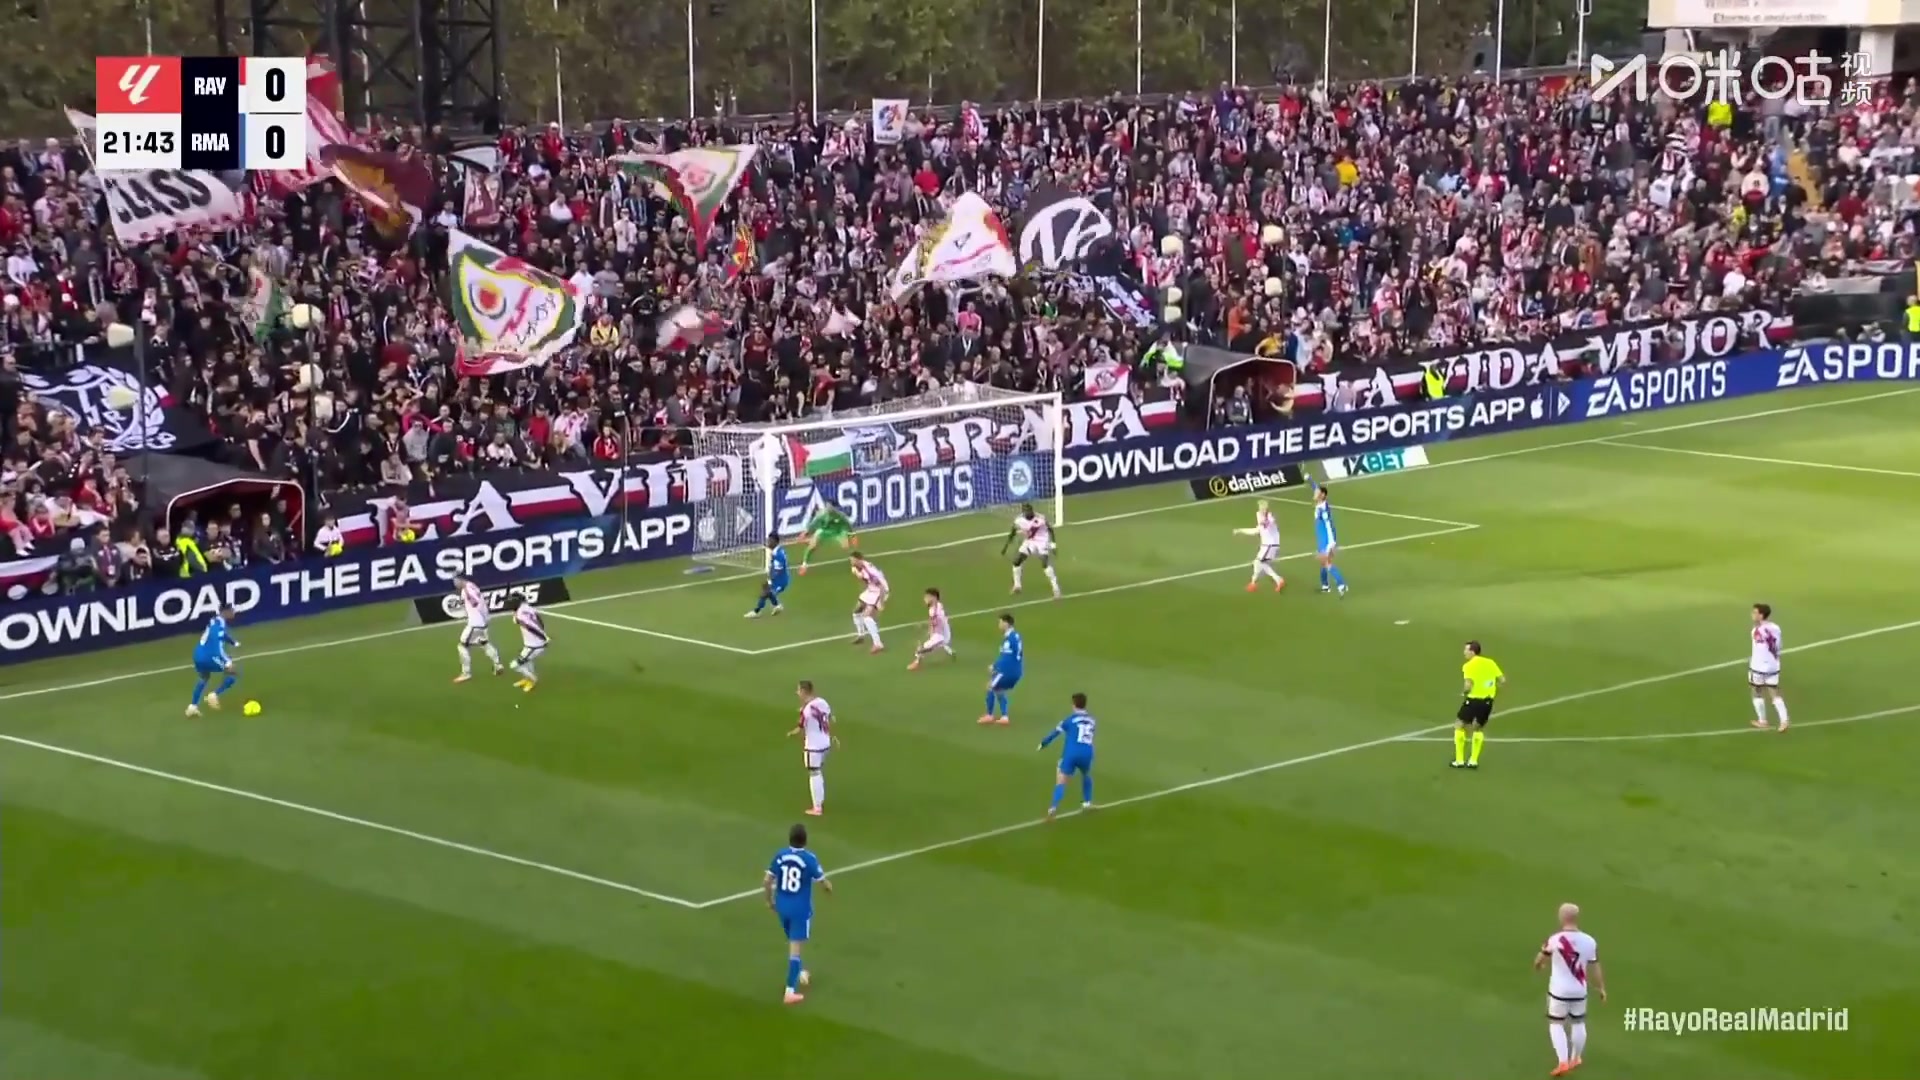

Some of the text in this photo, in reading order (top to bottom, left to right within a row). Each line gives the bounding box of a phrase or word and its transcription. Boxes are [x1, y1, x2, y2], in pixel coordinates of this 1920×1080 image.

[1586, 361, 1727, 417] EA SPORTS
[1777, 345, 1819, 388] EA
[1061, 396, 1525, 486] DOWNLOAD THE EA SPORTS APP
[837, 465, 974, 525] SPORTS
[1228, 469, 1288, 494] dafabet
[270, 560, 360, 606] THE
[370, 554, 428, 591] EA
[435, 527, 604, 581] SPORTS
[612, 514, 691, 555] APP
[1077, 722, 1095, 745] 15
[780, 865, 801, 893] 18
